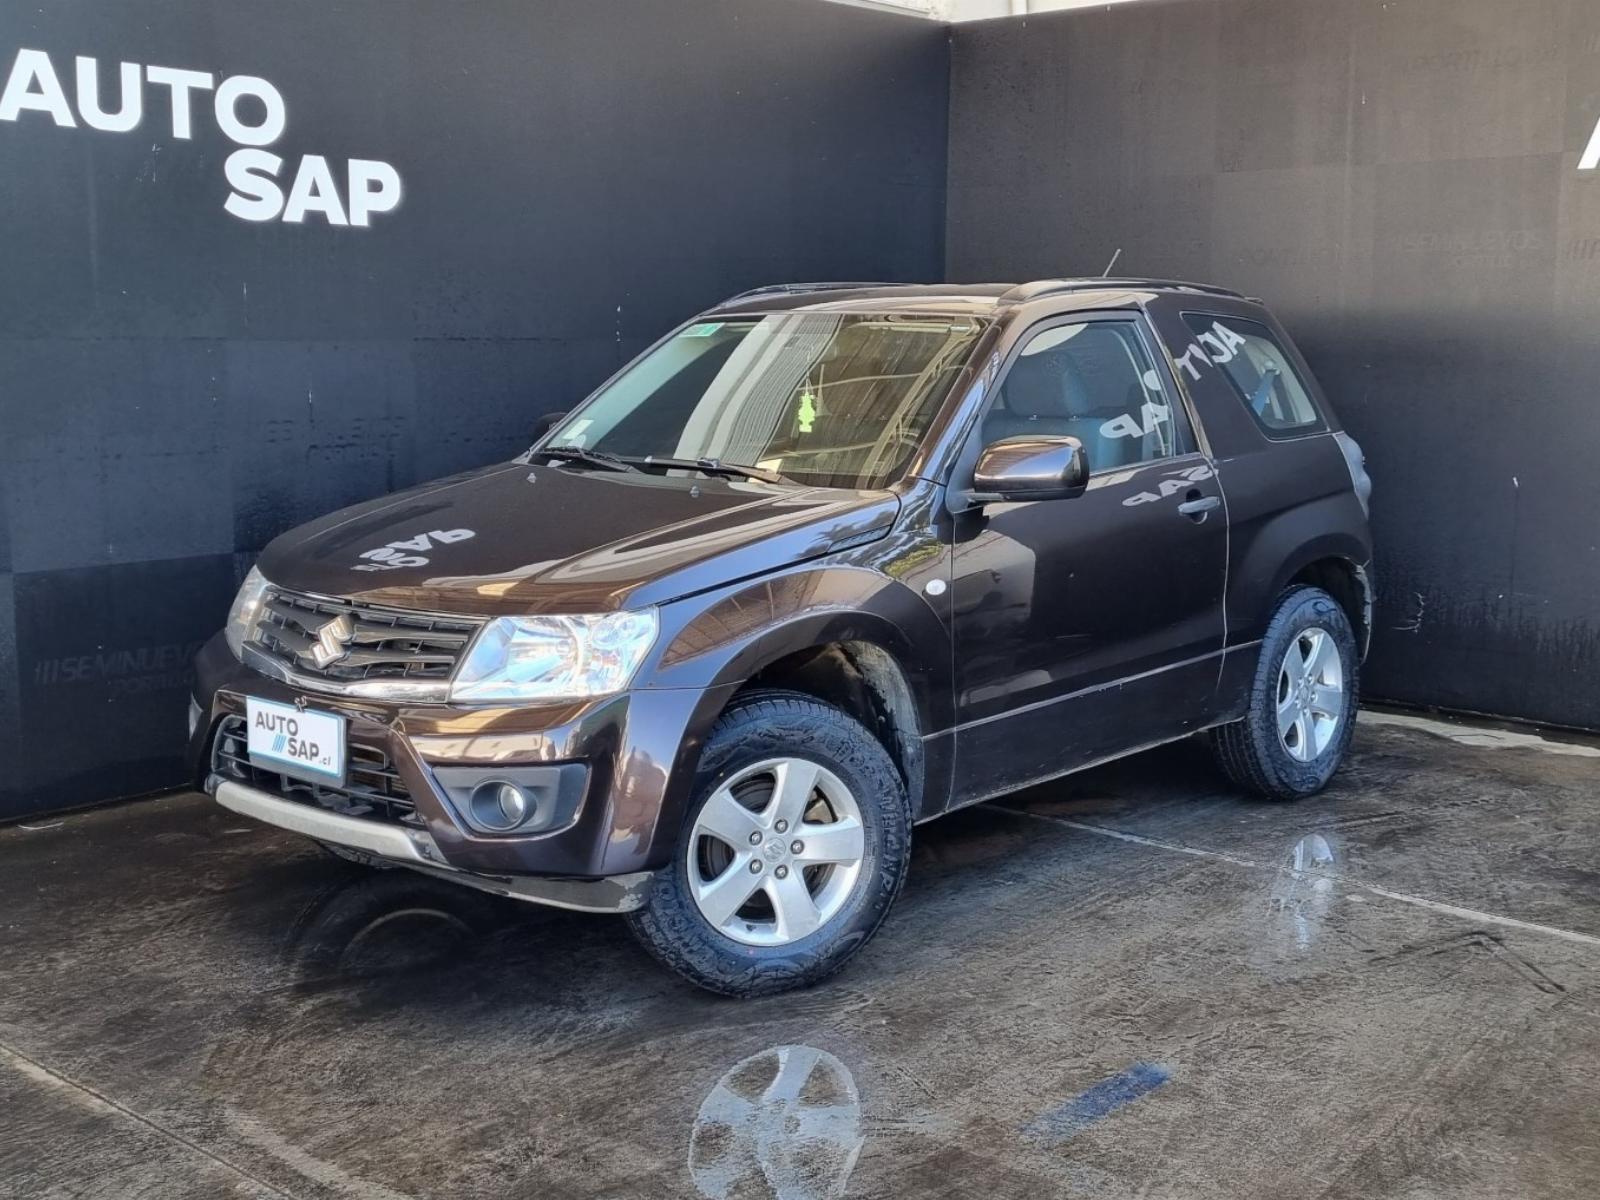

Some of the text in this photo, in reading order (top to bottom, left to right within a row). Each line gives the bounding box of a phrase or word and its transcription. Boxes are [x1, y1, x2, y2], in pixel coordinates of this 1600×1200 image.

[0, 48, 285, 146] AUTO
[224, 148, 401, 226] SAP
[255, 711, 298, 737] AUTO
[287, 737, 319, 761] SAP
